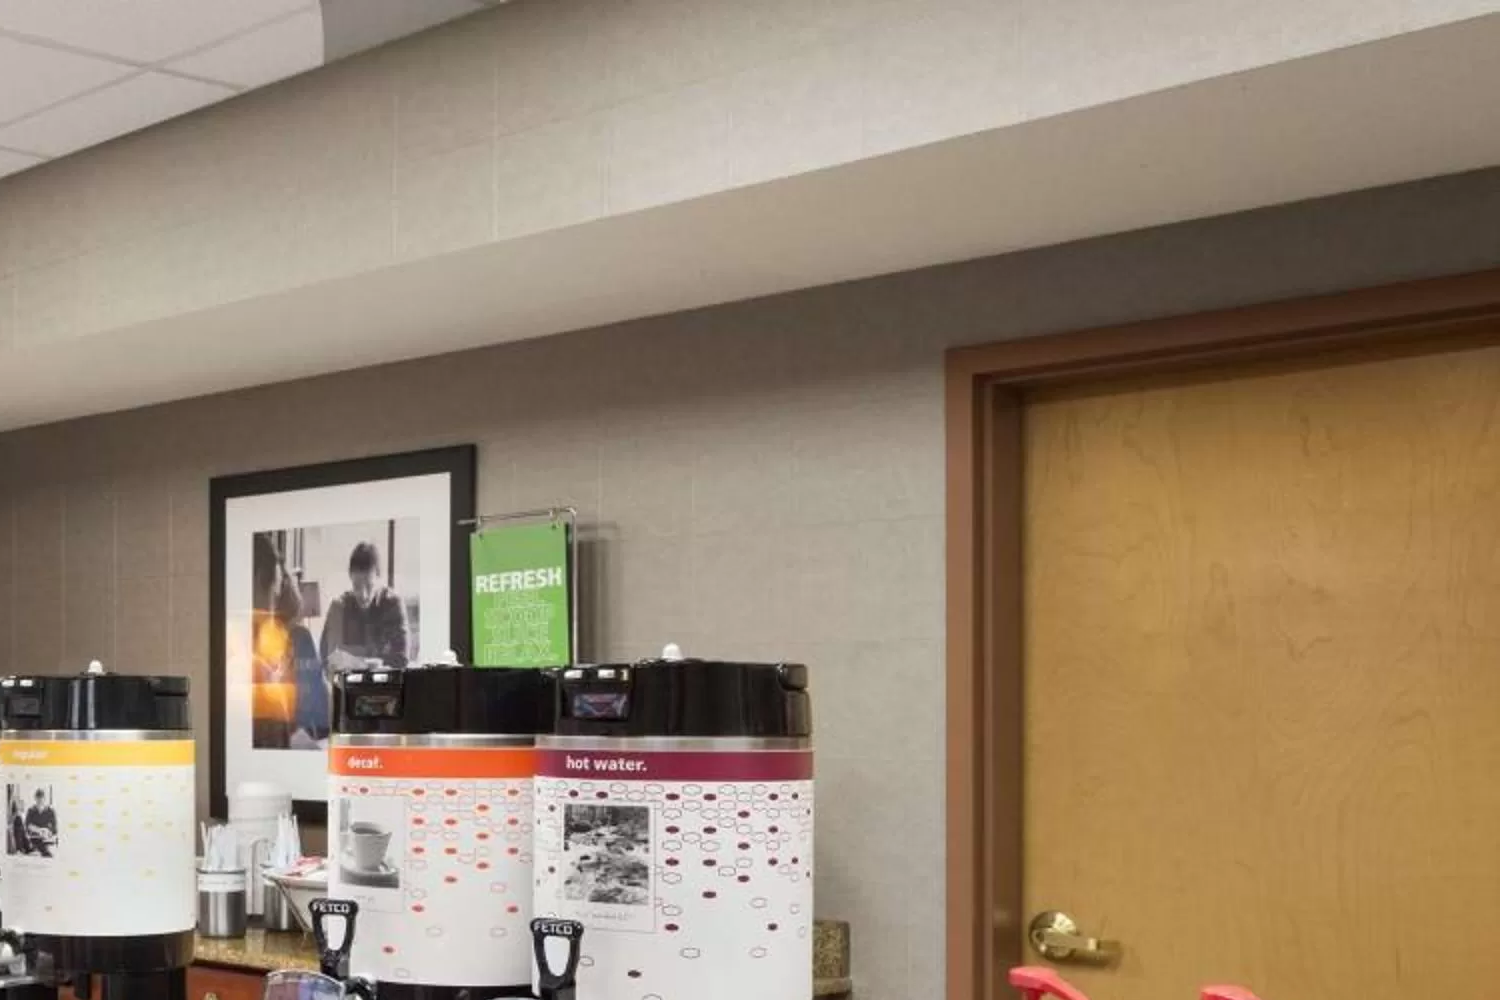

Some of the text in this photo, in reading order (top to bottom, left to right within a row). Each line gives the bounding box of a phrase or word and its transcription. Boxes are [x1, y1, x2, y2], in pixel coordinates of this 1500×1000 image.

[476, 566, 562, 594] REFRESH
[565, 754, 647, 772] hot water.
